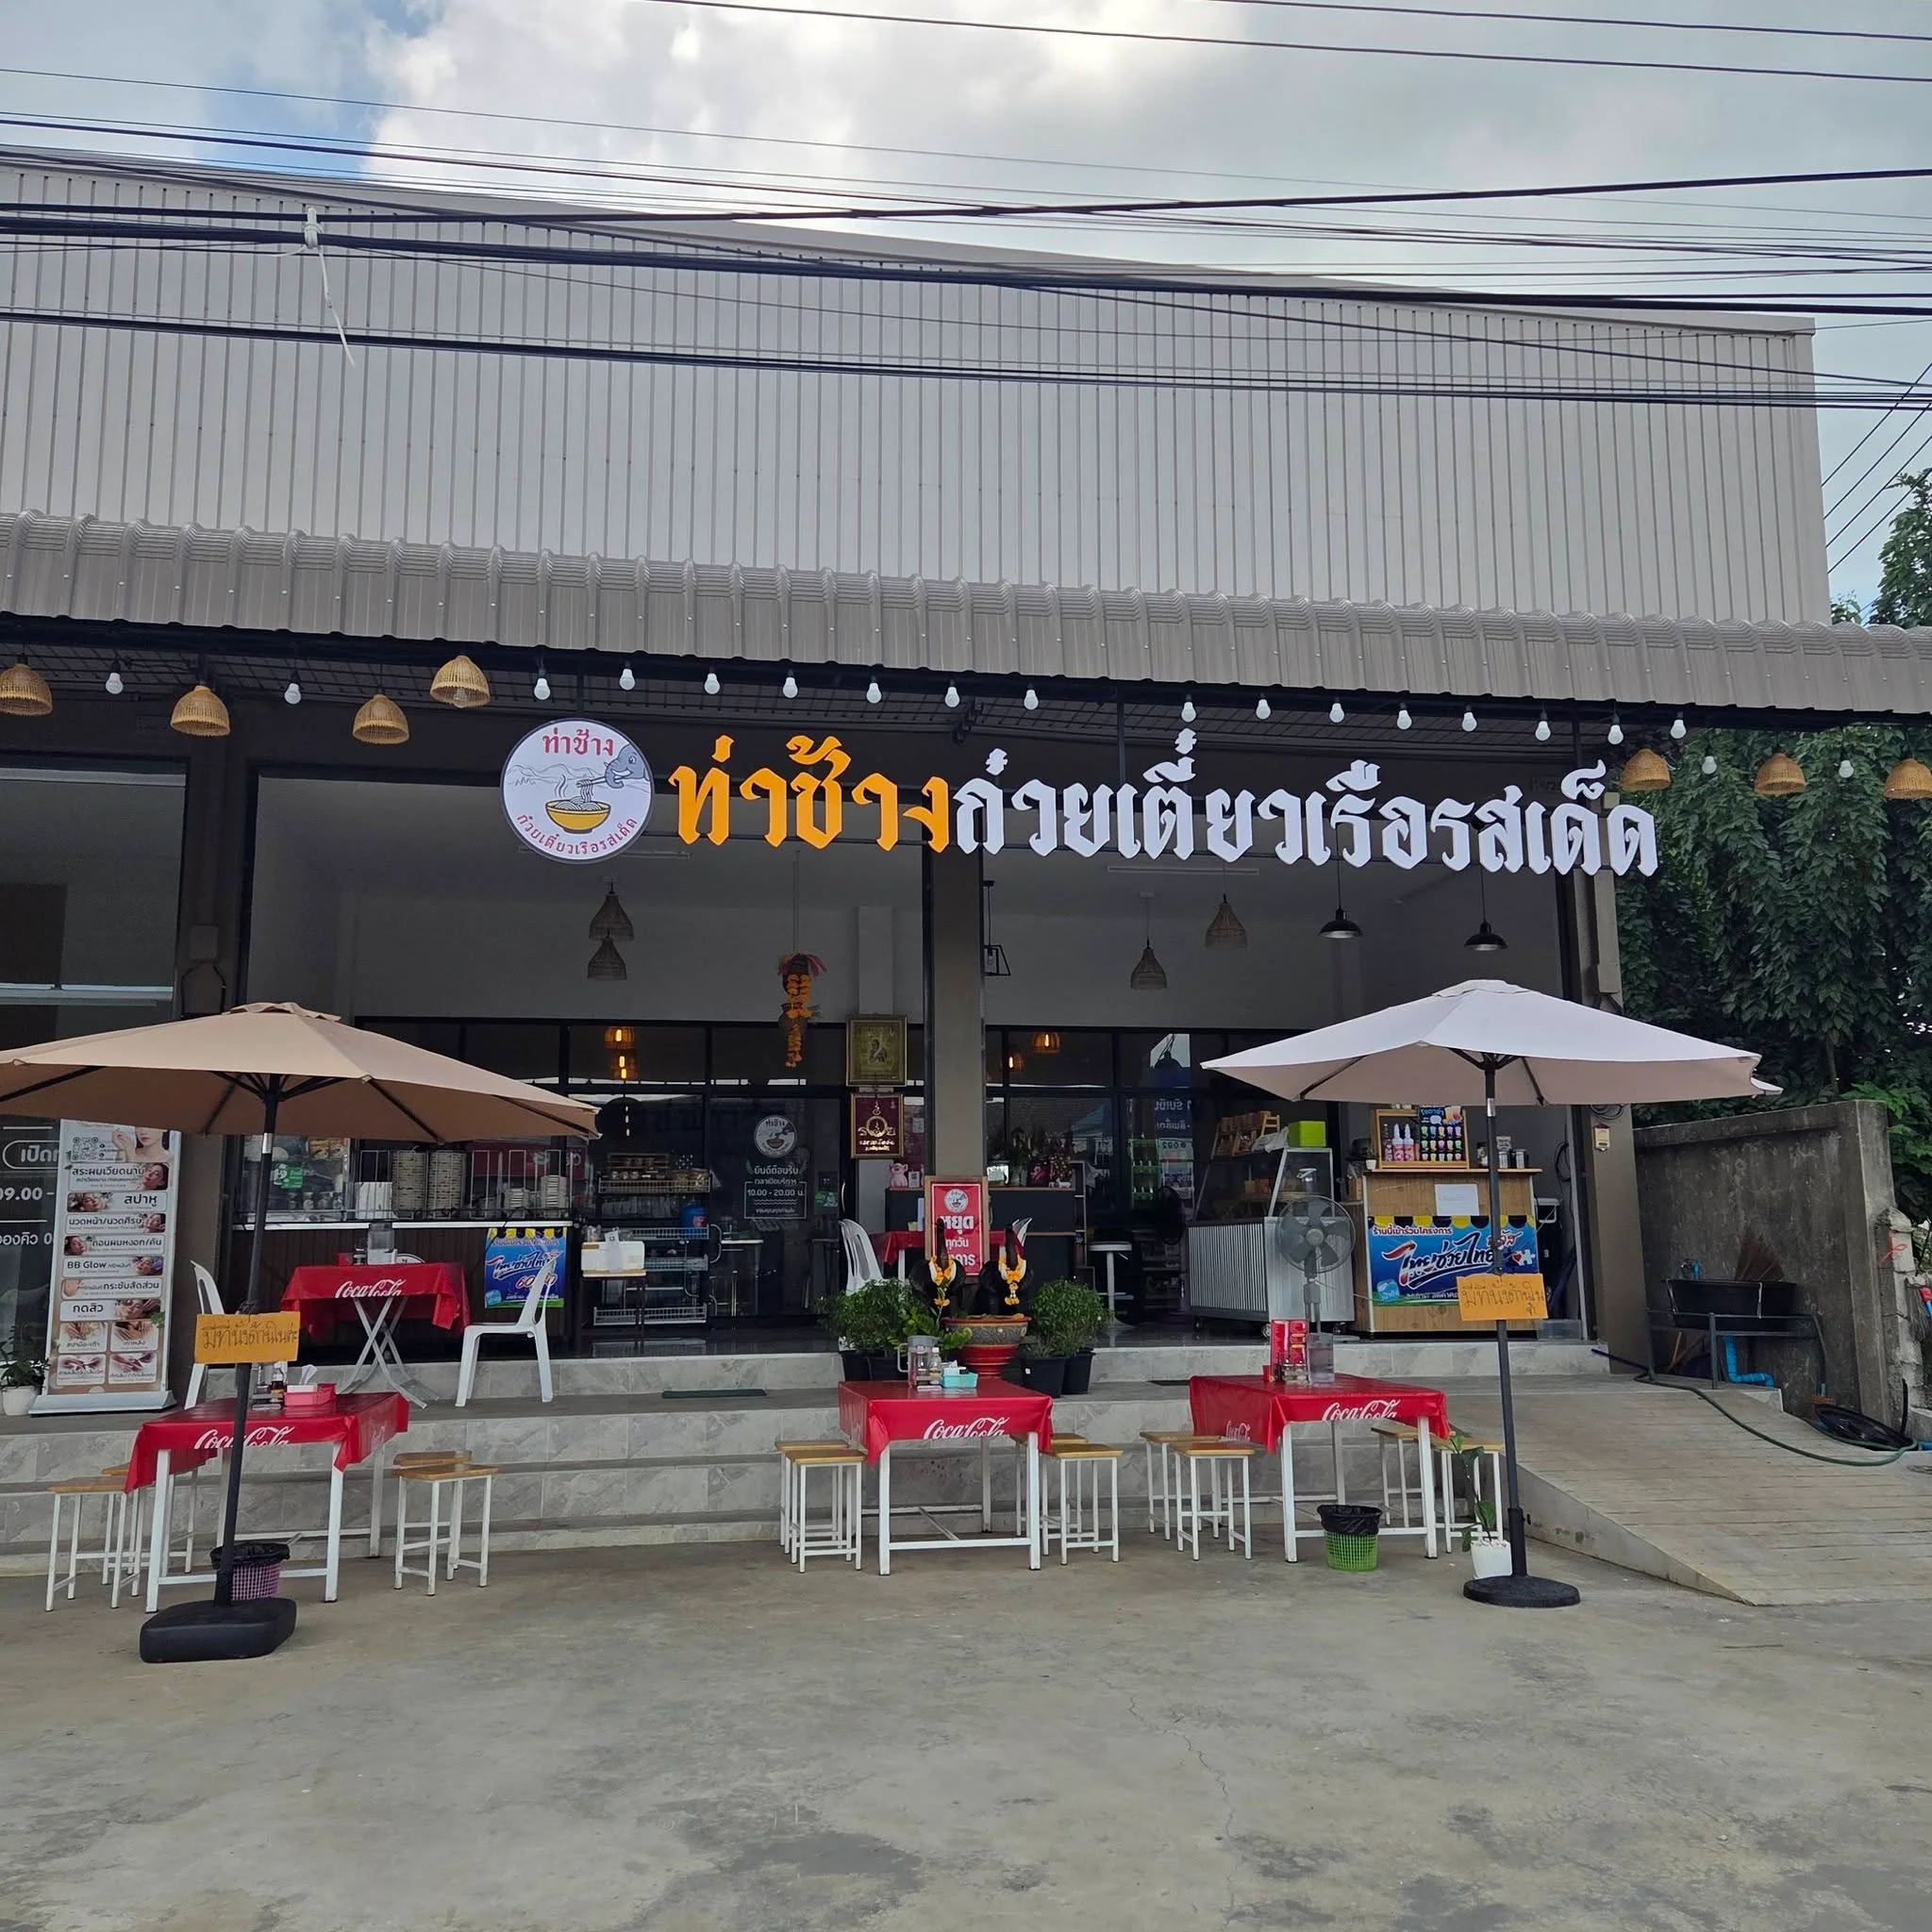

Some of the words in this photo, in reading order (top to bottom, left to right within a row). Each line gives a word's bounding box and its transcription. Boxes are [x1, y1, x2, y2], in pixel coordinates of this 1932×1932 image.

[542, 727, 614, 756] ท่าช้าง
[668, 734, 949, 854] ท่าช้าง
[951, 727, 1659, 877] ก๋วยเตี๋ยวเรือรสเด็ด
[124, 1193, 158, 1208] สปาหู
[0, 1232, 39, 1246] องคิว
[83, 1260, 107, 1269] Glow
